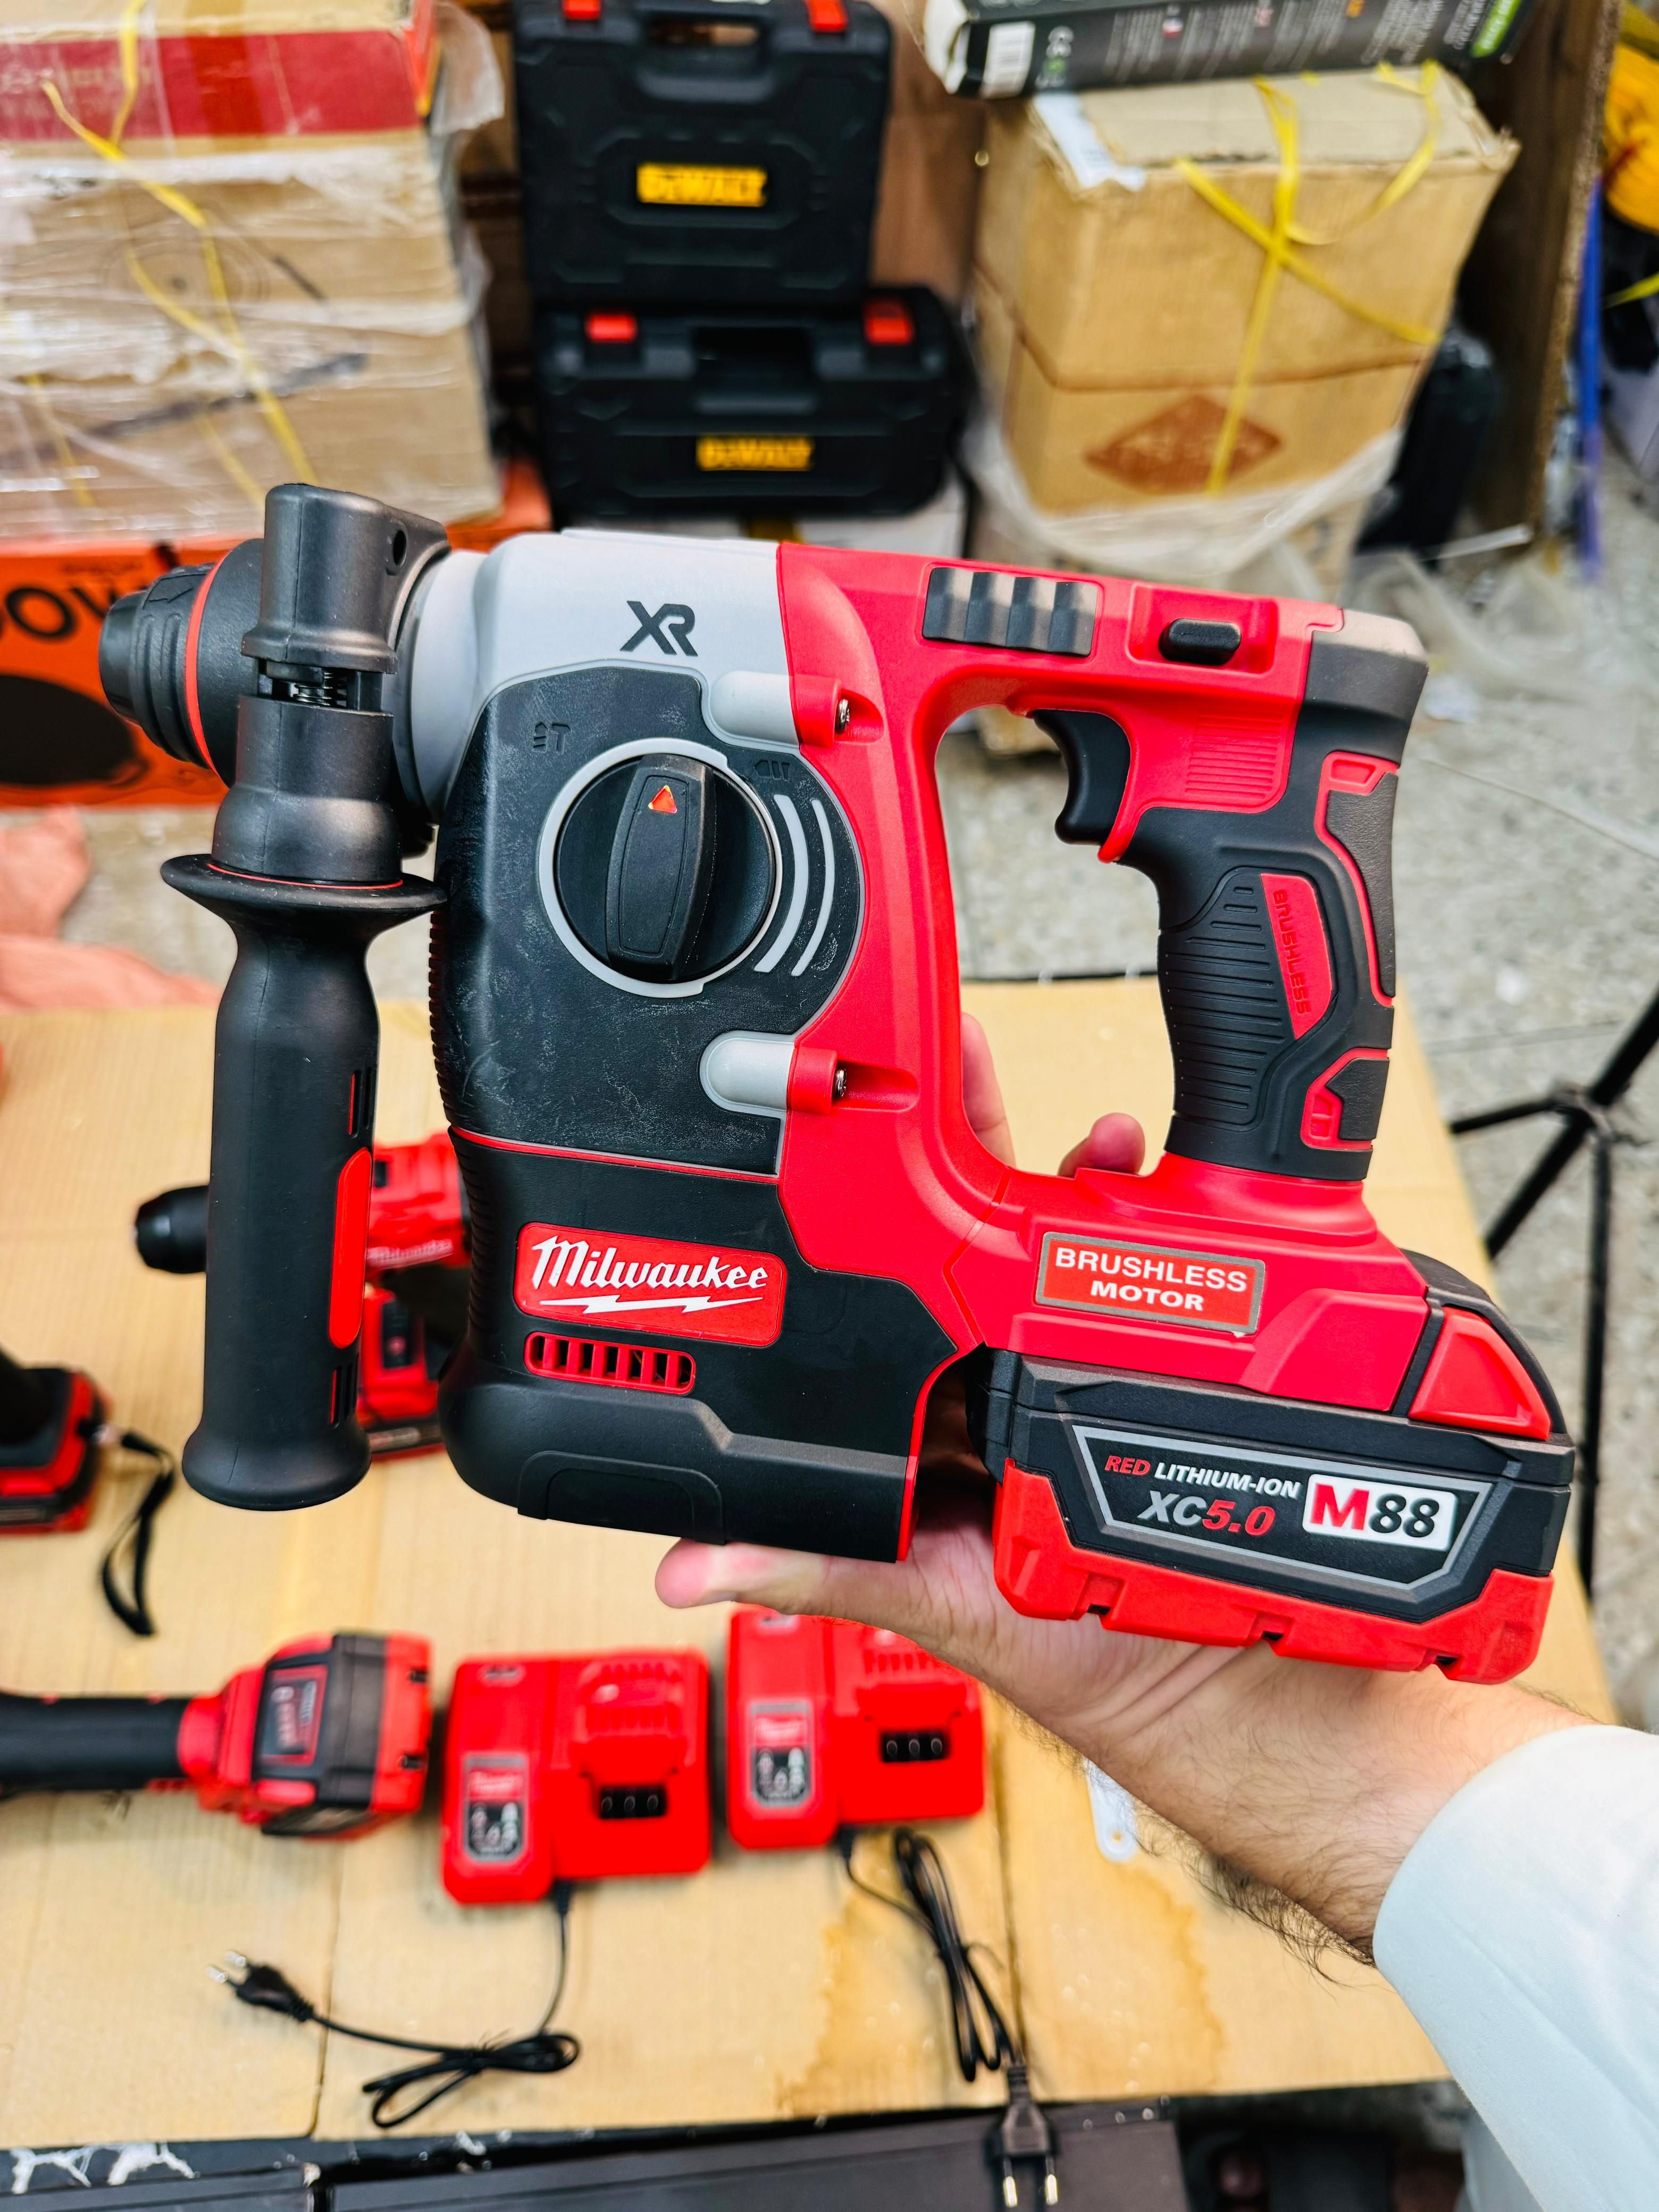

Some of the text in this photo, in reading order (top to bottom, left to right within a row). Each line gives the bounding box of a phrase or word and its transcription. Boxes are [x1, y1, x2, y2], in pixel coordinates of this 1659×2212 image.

[620, 600, 699, 657] XR
[1273, 889, 1311, 1015] BRUSHLESS
[532, 1235, 769, 1289] Milwaukee
[1055, 1247, 1247, 1293] BRUSHLESS
[1090, 1280, 1204, 1312] MOTOR
[1104, 1455, 1440, 1538] RED LITHIUM-ION M88
[1137, 1490, 1276, 1537] XC5.0
